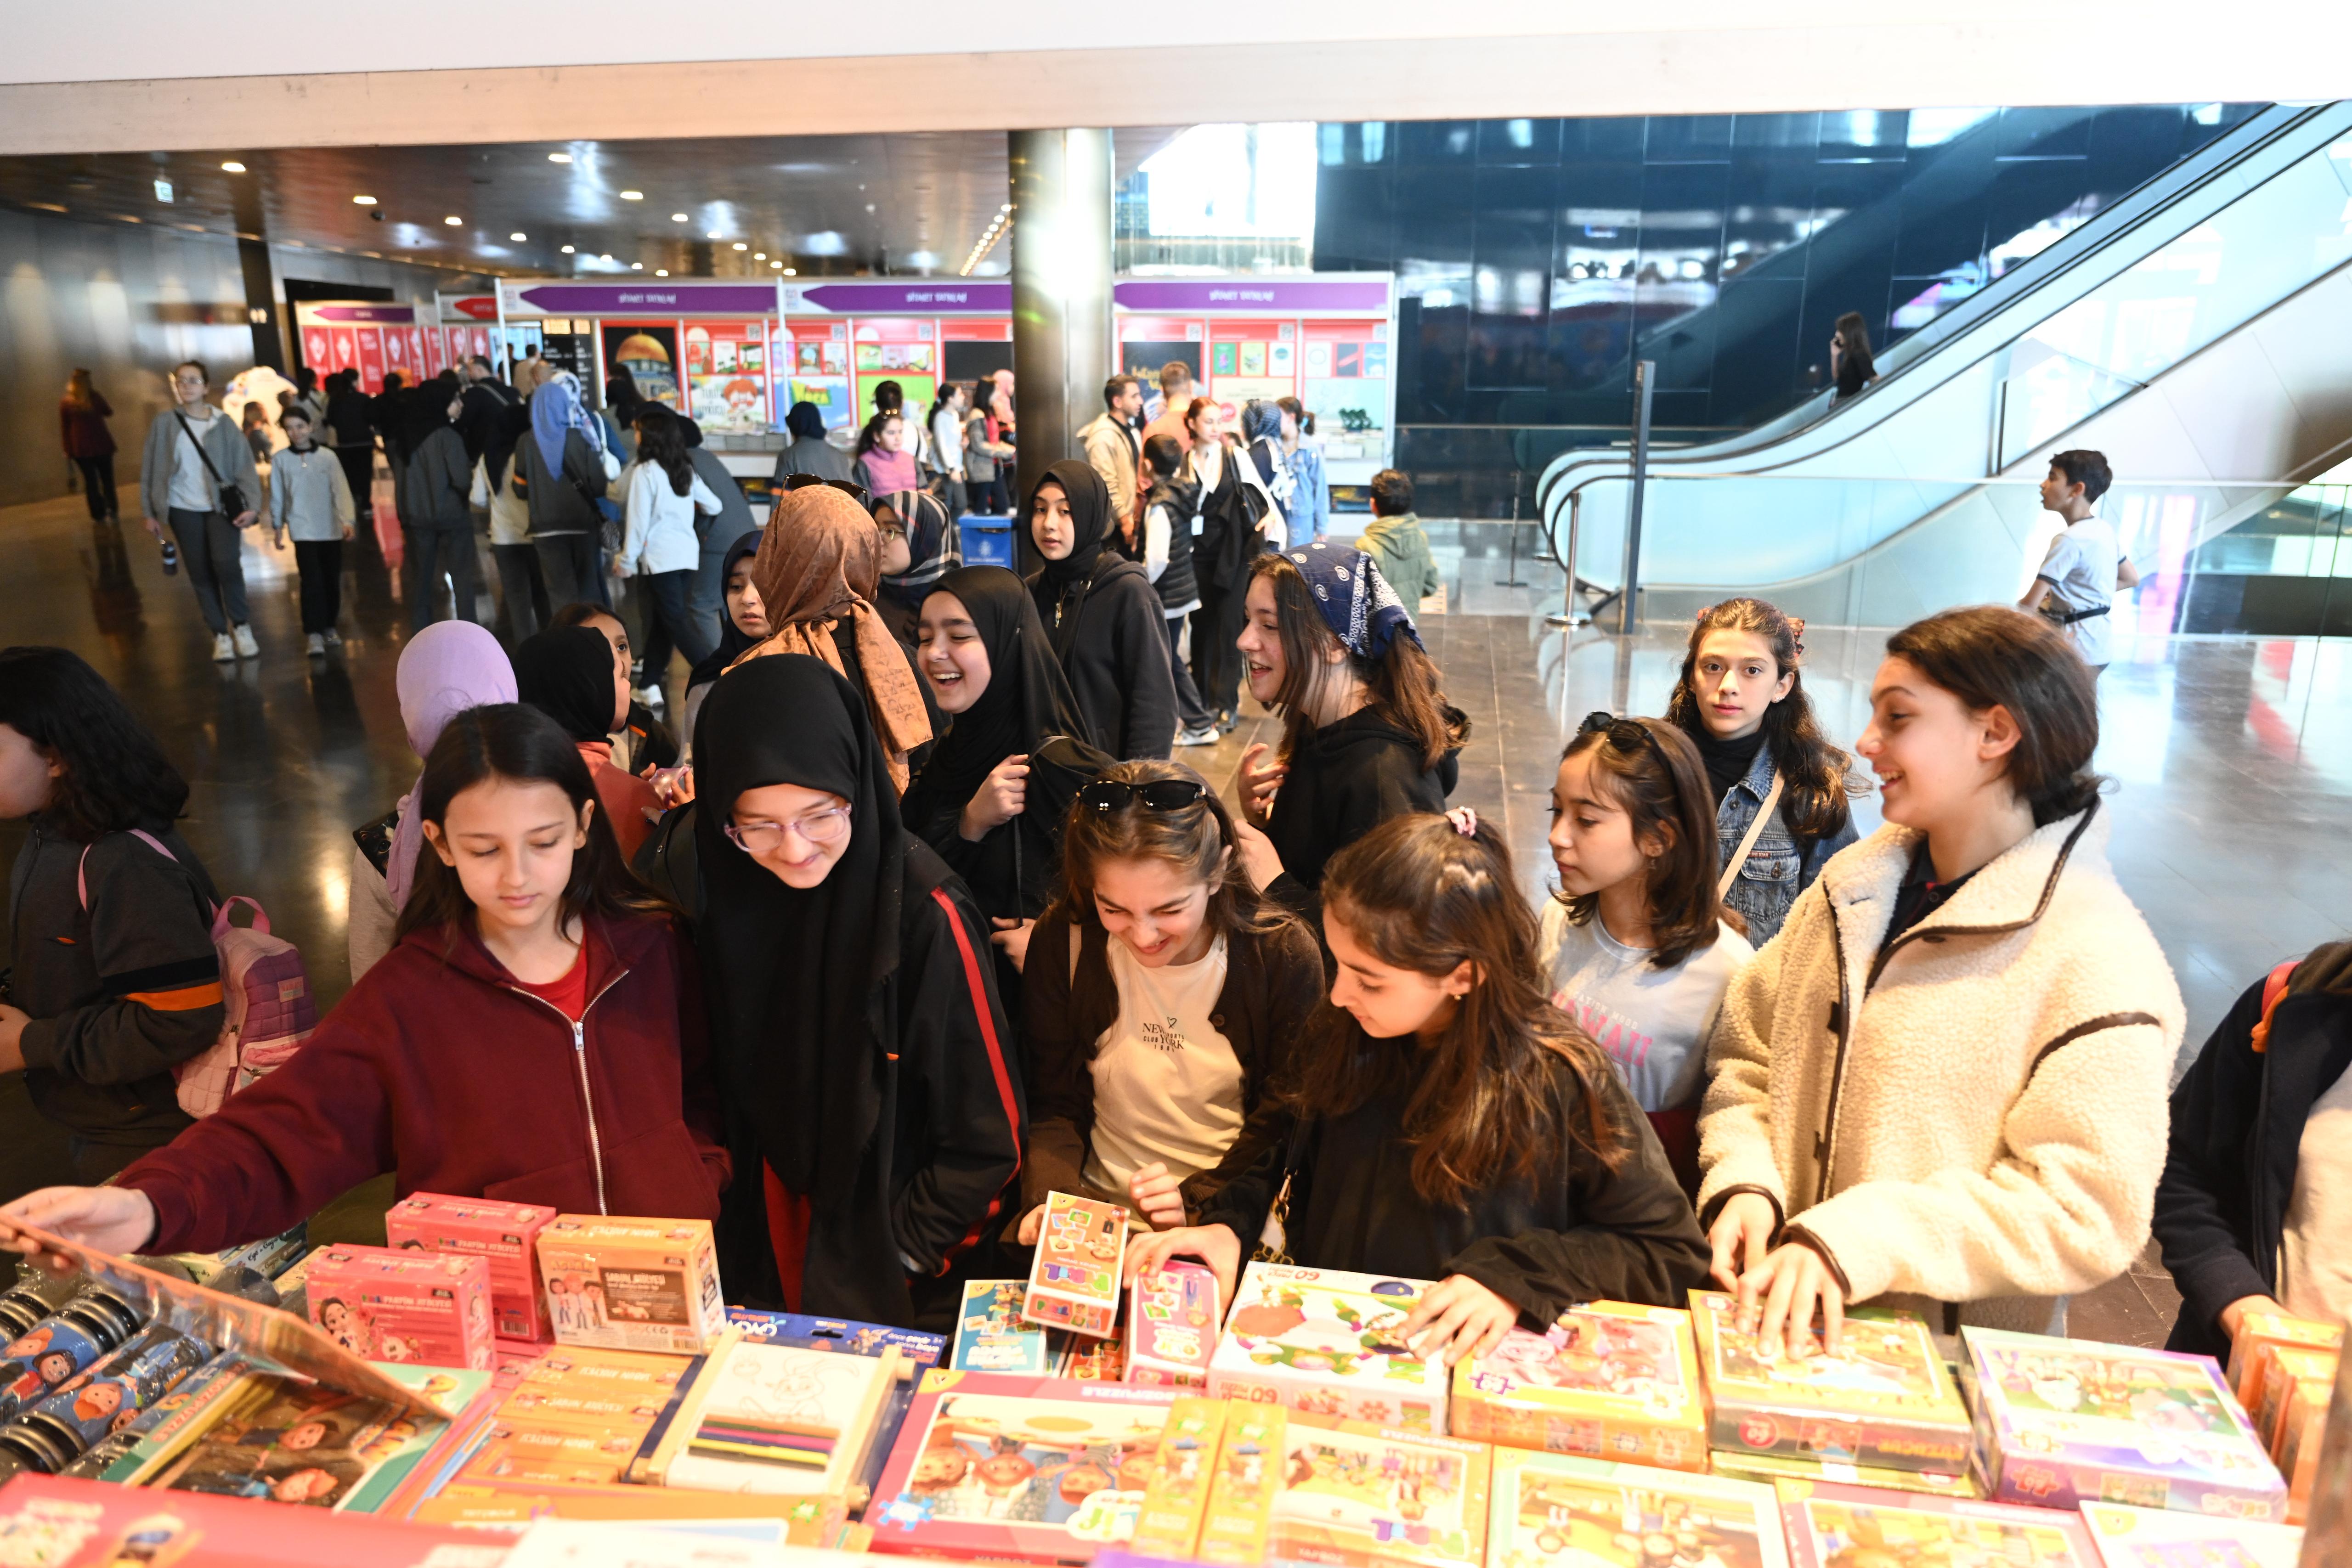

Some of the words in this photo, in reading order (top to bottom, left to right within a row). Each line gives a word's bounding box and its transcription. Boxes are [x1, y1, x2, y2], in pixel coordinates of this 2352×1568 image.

[1142, 1022, 1166, 1034] NEW
[1611, 1011, 1638, 1030] MOOD
[1160, 1034, 1184, 1049] YORK
[1295, 1270, 1320, 1281] 60
[1250, 1387, 1278, 1403] 60
